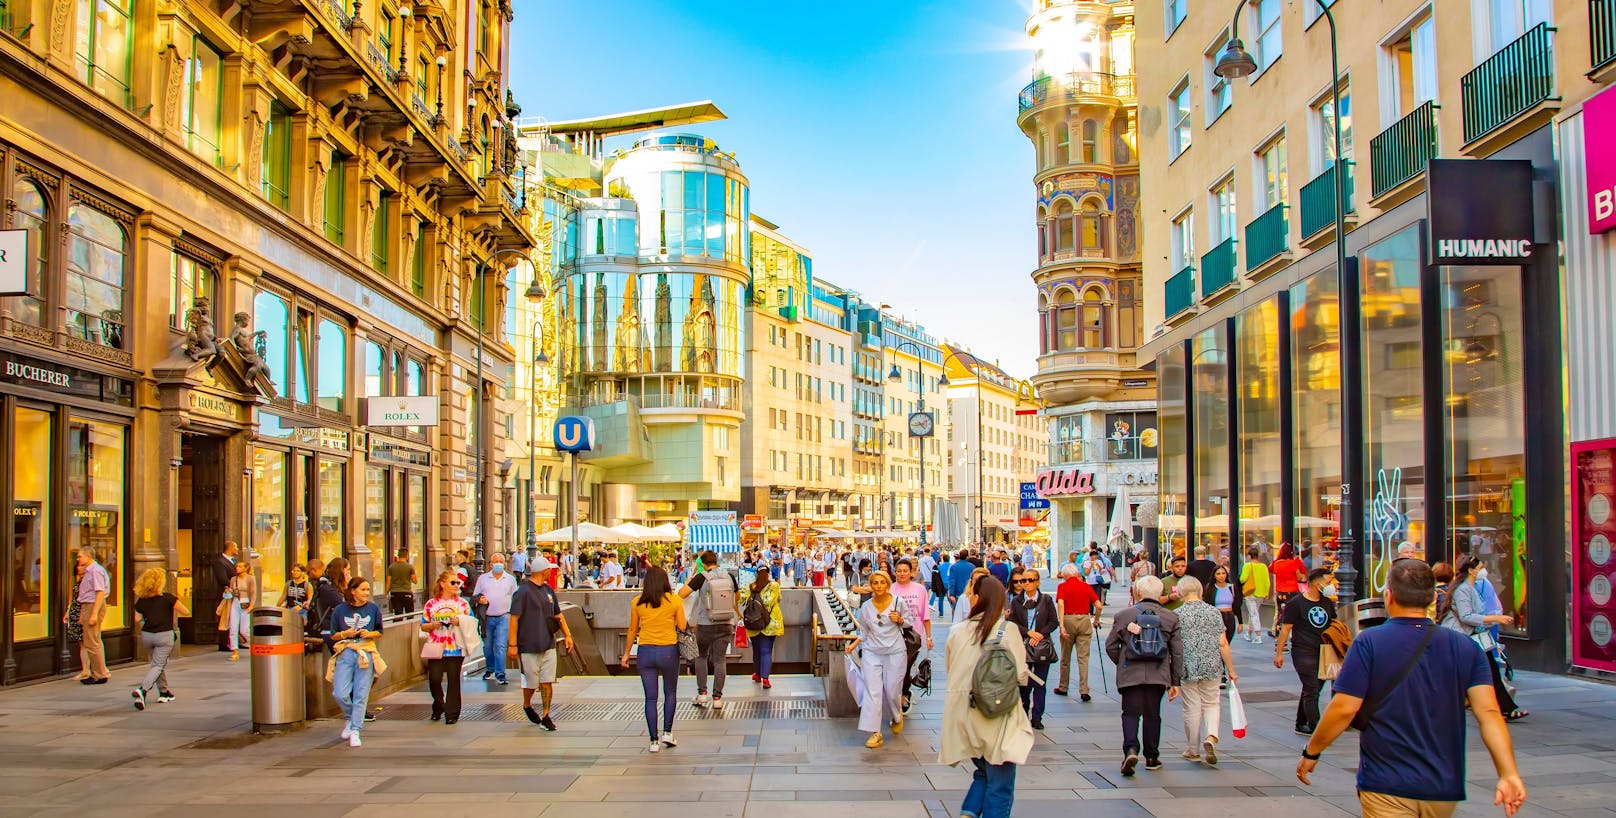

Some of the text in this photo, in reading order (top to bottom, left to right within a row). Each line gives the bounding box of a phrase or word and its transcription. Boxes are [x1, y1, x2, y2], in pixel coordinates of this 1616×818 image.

[1594, 185, 1616, 221] B
[1439, 239, 1532, 258] HUMANIC
[5, 360, 70, 387] BUCHERER
[198, 396, 227, 414] ROLEX
[384, 412, 420, 421] ROLEX
[558, 423, 581, 447] U
[1021, 492, 1039, 500] CHA
[78, 510, 97, 518] ROLEX
